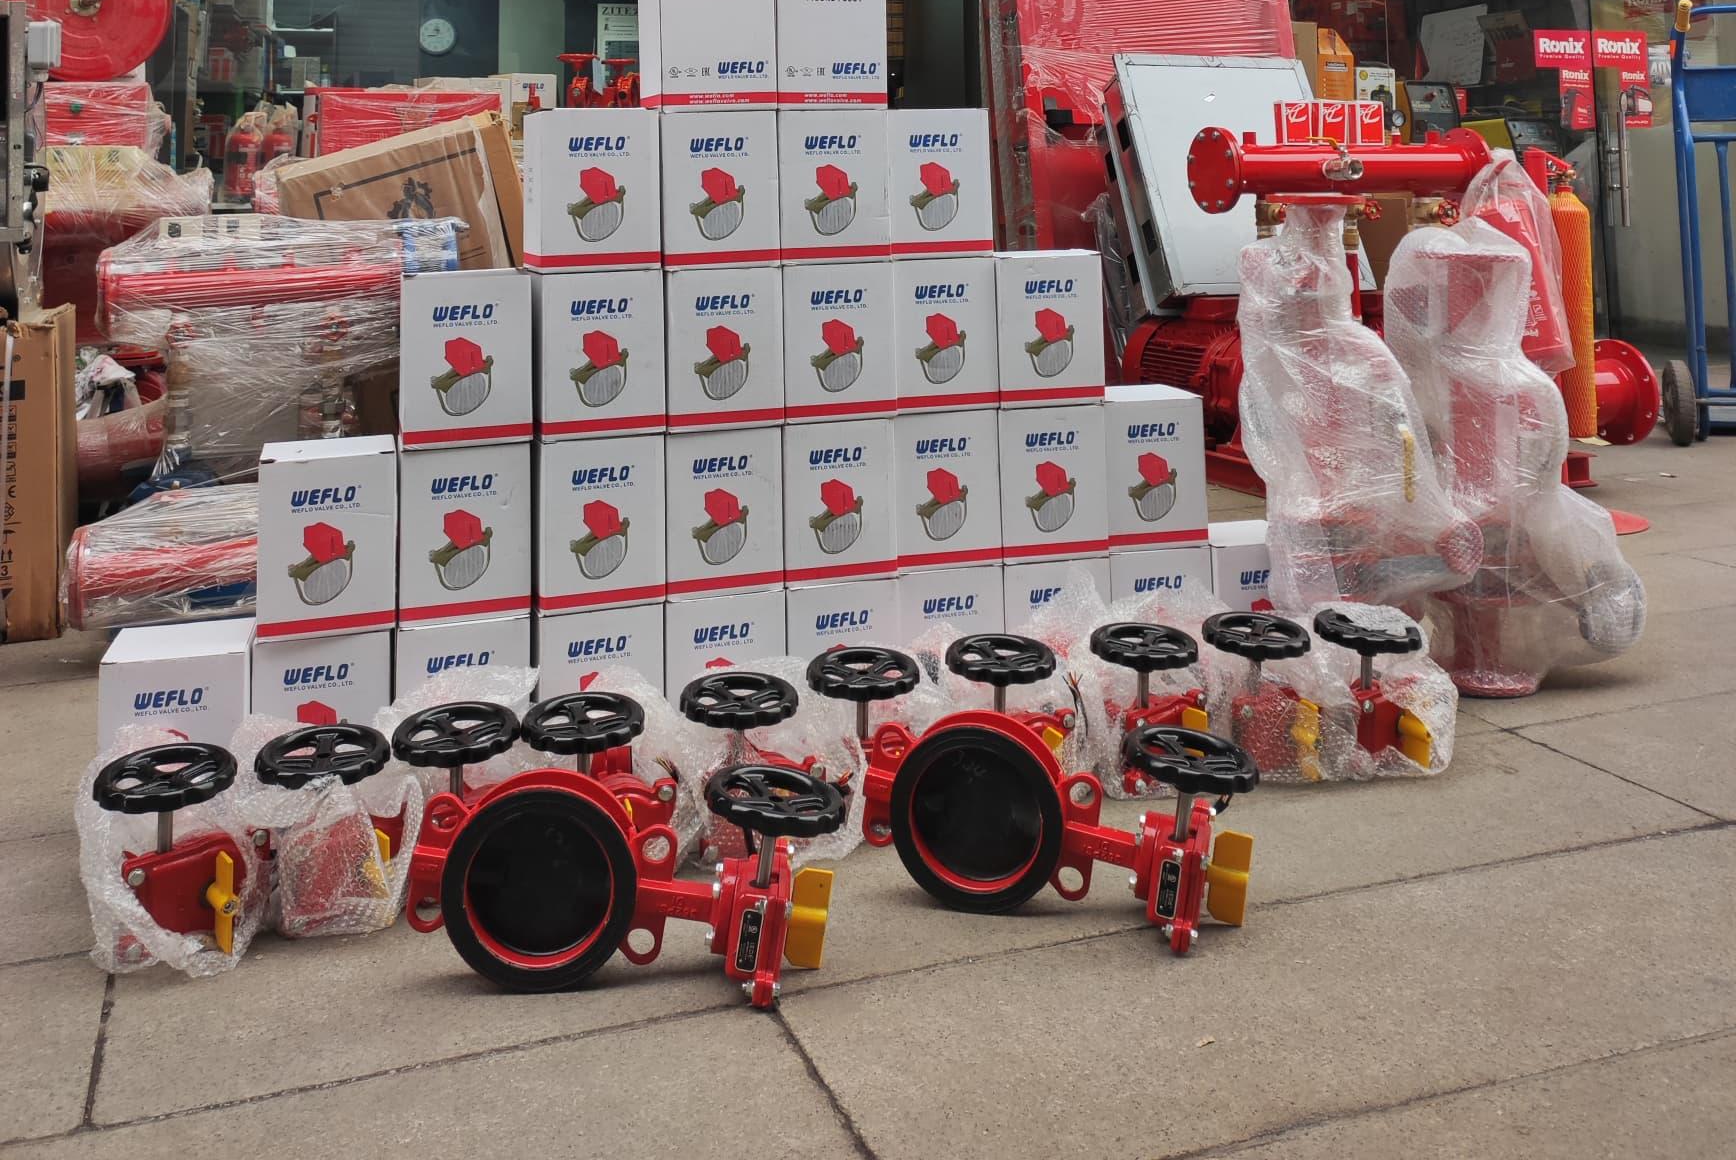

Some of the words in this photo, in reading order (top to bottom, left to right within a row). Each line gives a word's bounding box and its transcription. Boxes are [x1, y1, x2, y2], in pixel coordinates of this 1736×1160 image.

[1539, 37, 1585, 53] Ronix
[1597, 38, 1641, 54] Ronix
[718, 61, 764, 74] WEFLO
[832, 63, 876, 74] WEFLO
[1562, 70, 1589, 81] Ronix
[1622, 71, 1645, 81] Ronix
[569, 137, 625, 151] WEFLO
[690, 137, 743, 152] WEFLO
[805, 136, 856, 149] WEFLO
[910, 134, 958, 147] WEFLO
[915, 284, 964, 299] WEFLO
[1025, 280, 1073, 294] WEFLO
[696, 295, 749, 311] WEFLO
[811, 289, 862, 305] WEFLO
[433, 304, 493, 321] WEFLO
[571, 298, 628, 315] WEFLO
[1128, 423, 1175, 438] WEFLO
[916, 438, 966, 454] WEFLO
[1026, 431, 1074, 447] WEFLO
[810, 447, 861, 464] WEFLO
[693, 455, 747, 473] WEFLO
[572, 466, 629, 485] WEFLO
[431, 474, 492, 494] WEFLO
[291, 486, 356, 507] WEFLO
[1241, 570, 1270, 585] WEF
[1030, 588, 1061, 604] WEF
[923, 595, 973, 614] WEFLO
[816, 610, 868, 630] WEFLO
[694, 623, 749, 643] WEFLO
[568, 636, 626, 657] WEFLO
[284, 664, 348, 685] WEFLO
[134, 688, 203, 710] WEFLO
